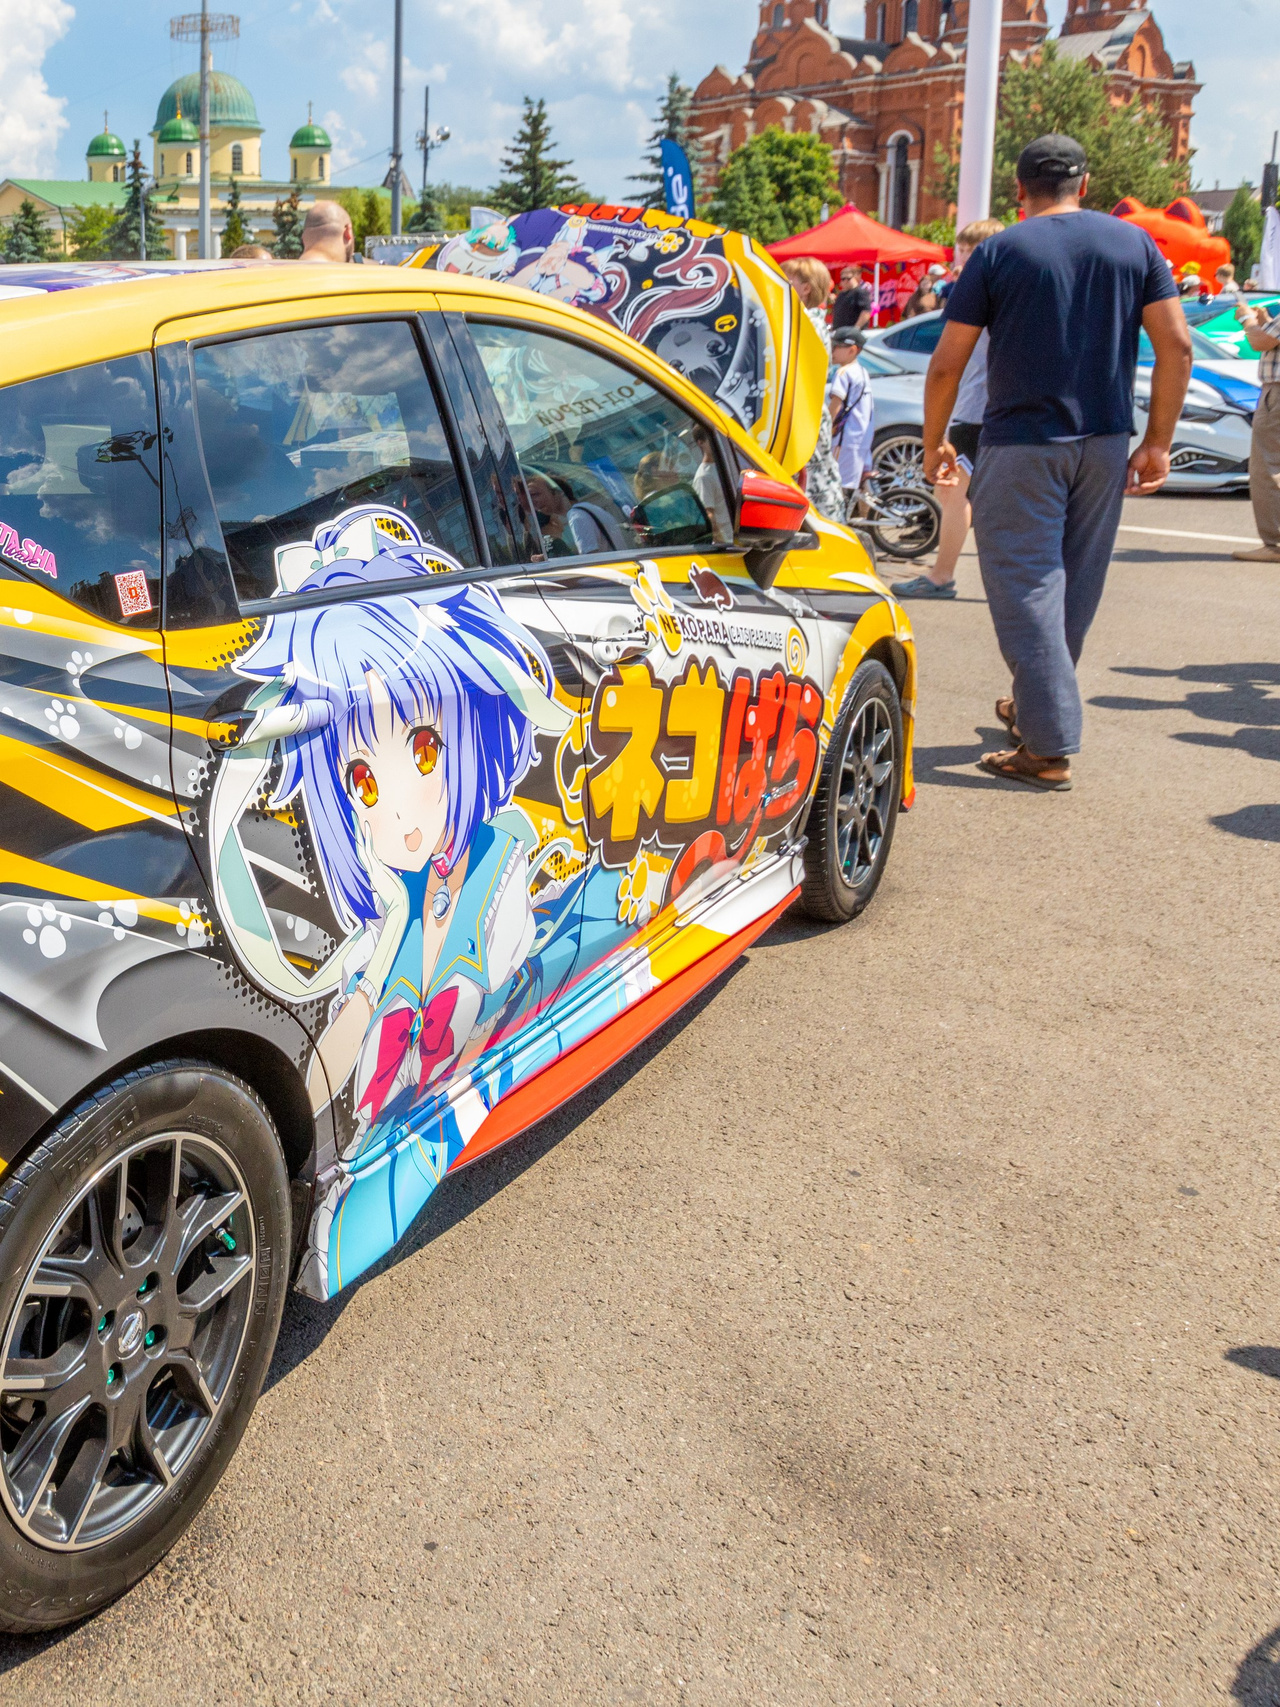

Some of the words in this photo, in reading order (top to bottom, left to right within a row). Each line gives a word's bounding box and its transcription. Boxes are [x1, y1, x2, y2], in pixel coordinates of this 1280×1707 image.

[660, 614, 729, 643] NEKOPARA
[731, 625, 749, 646] CATS
[590, 663, 821, 841] ネコぱら
